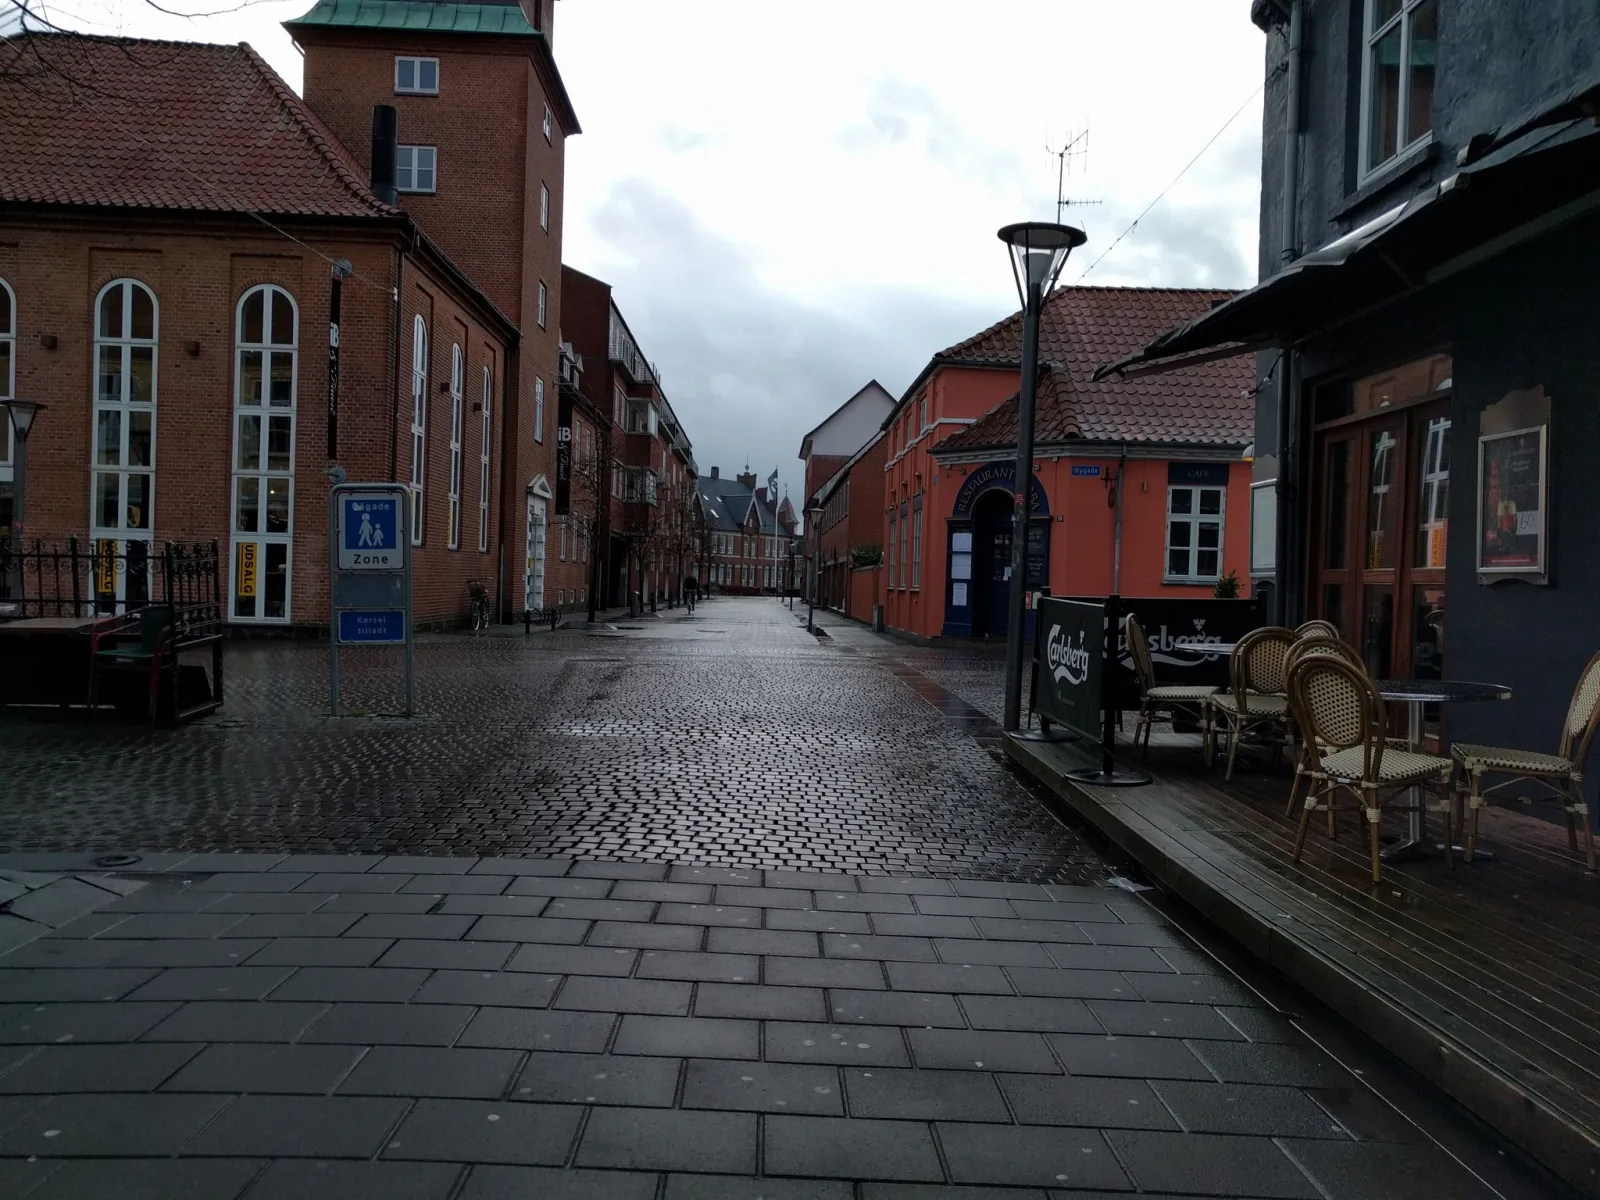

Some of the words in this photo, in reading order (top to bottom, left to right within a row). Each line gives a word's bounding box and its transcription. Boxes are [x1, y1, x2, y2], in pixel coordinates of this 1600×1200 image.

[958, 468, 1015, 512] RESTAURANT
[352, 502, 390, 512] gade
[244, 544, 254, 594] UDSALG
[354, 554, 389, 564] Zone
[357, 627, 387, 635] tilladt
[1047, 624, 1090, 685] Carlsberg
